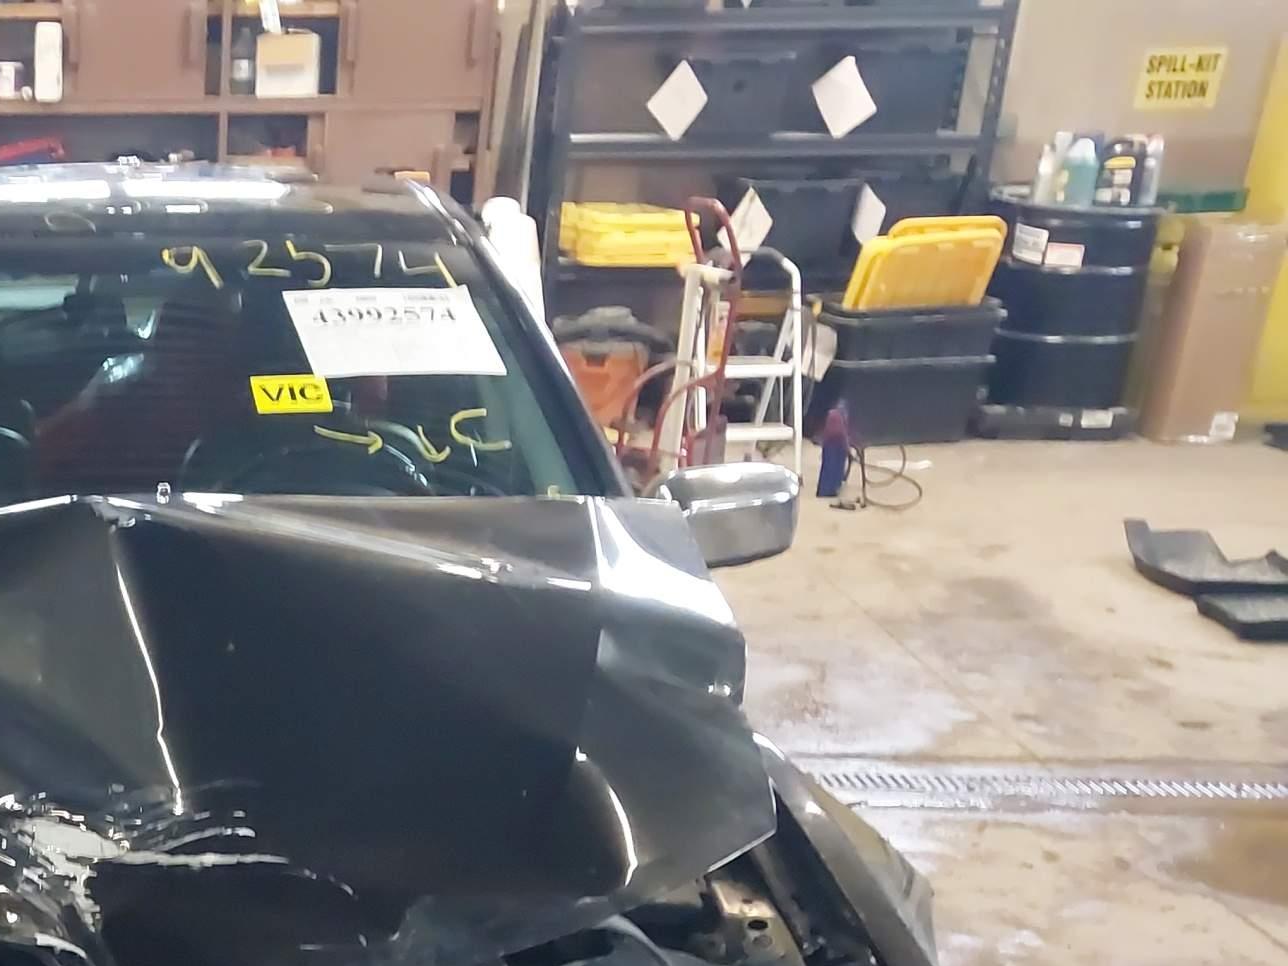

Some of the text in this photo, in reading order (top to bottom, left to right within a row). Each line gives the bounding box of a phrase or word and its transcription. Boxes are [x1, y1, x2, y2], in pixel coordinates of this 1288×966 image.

[1146, 53, 1221, 74] SPILL-KIT
[1145, 79, 1209, 99] STATION
[312, 306, 456, 324] 43992574
[259, 383, 323, 404] VIC
